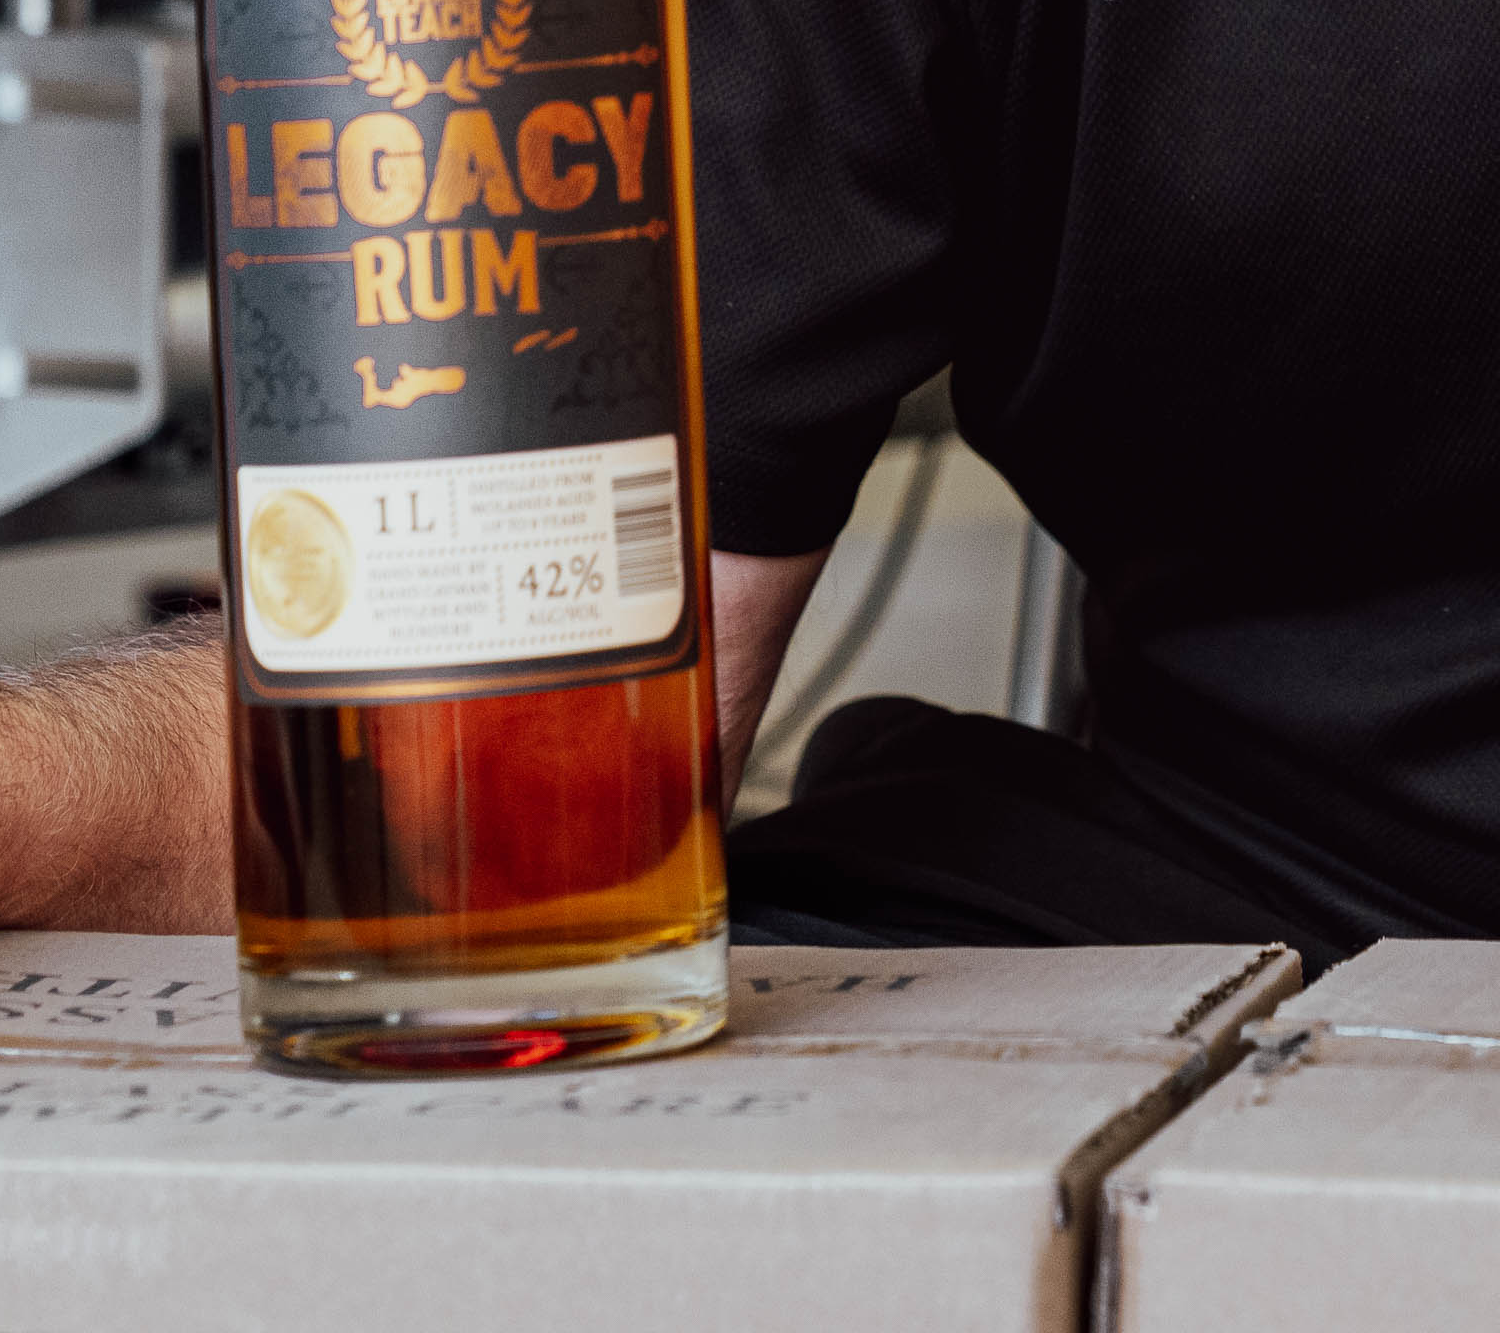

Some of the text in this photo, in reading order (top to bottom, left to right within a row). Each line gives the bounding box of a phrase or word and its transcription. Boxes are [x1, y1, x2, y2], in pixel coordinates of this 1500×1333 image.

[380, 1, 483, 45] TEACH
[227, 93, 654, 229] LEGACY
[351, 229, 541, 327] RUM
[518, 550, 606, 601] 42%
